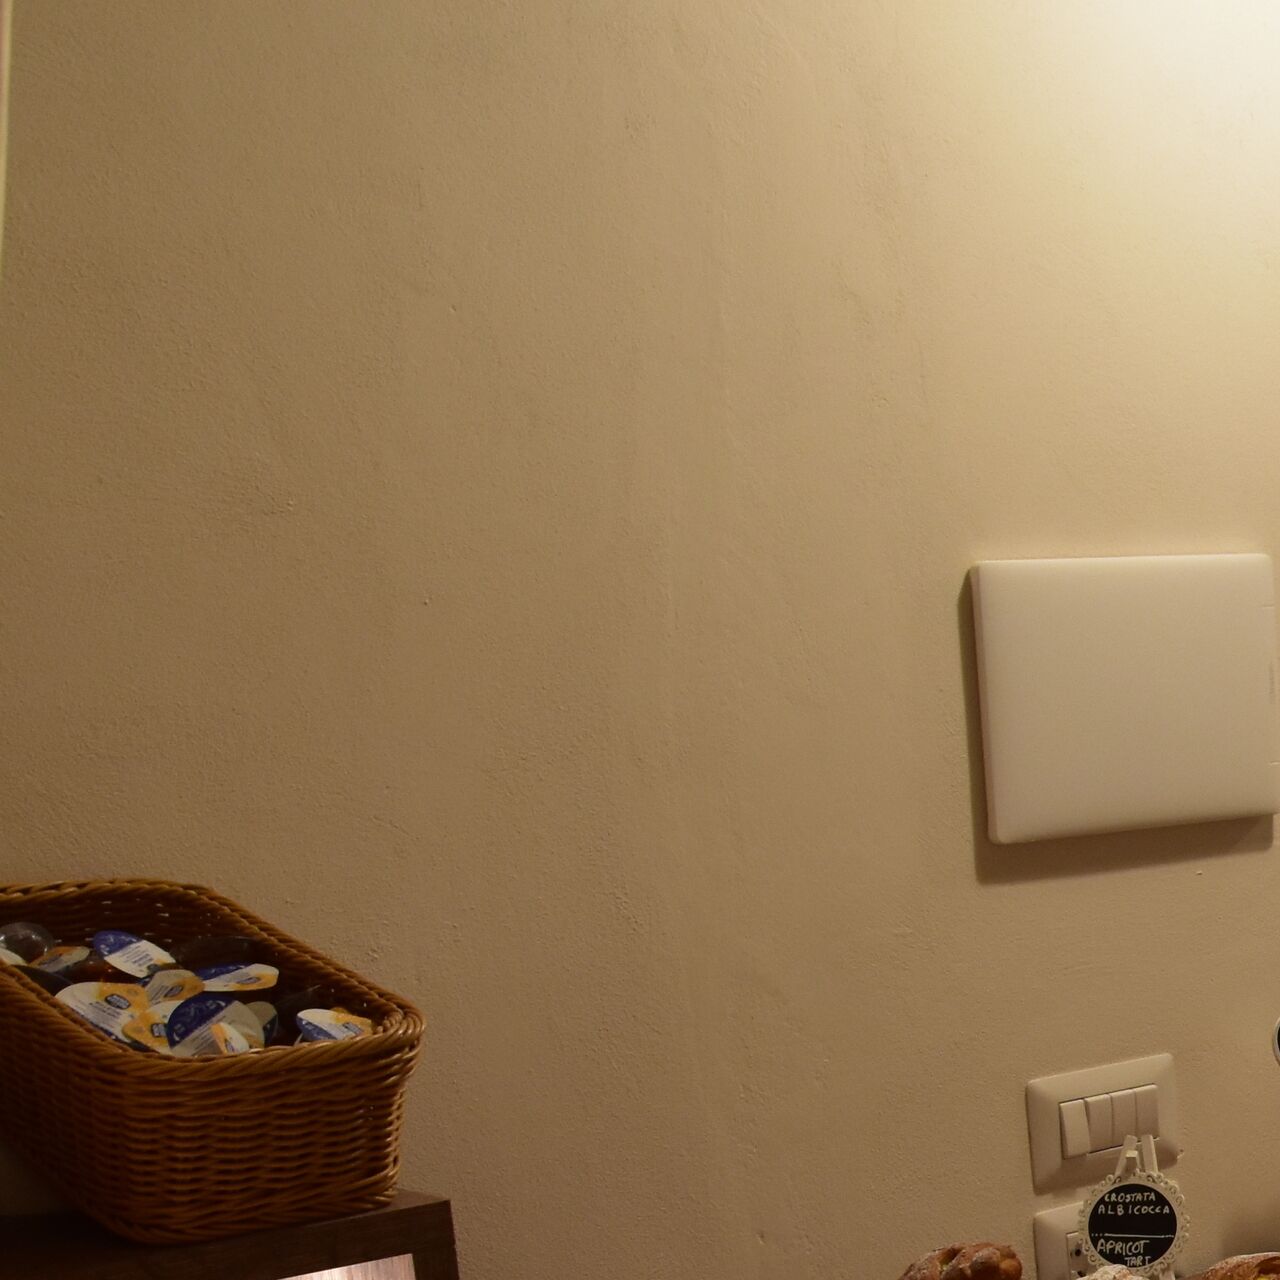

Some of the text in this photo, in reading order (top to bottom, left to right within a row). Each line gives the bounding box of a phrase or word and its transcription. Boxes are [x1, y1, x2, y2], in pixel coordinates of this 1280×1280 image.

[1104, 1191, 1156, 1203] CROSTATA
[1097, 1239, 1150, 1255] APRICOT
[1124, 1255, 1152, 1267] TART
